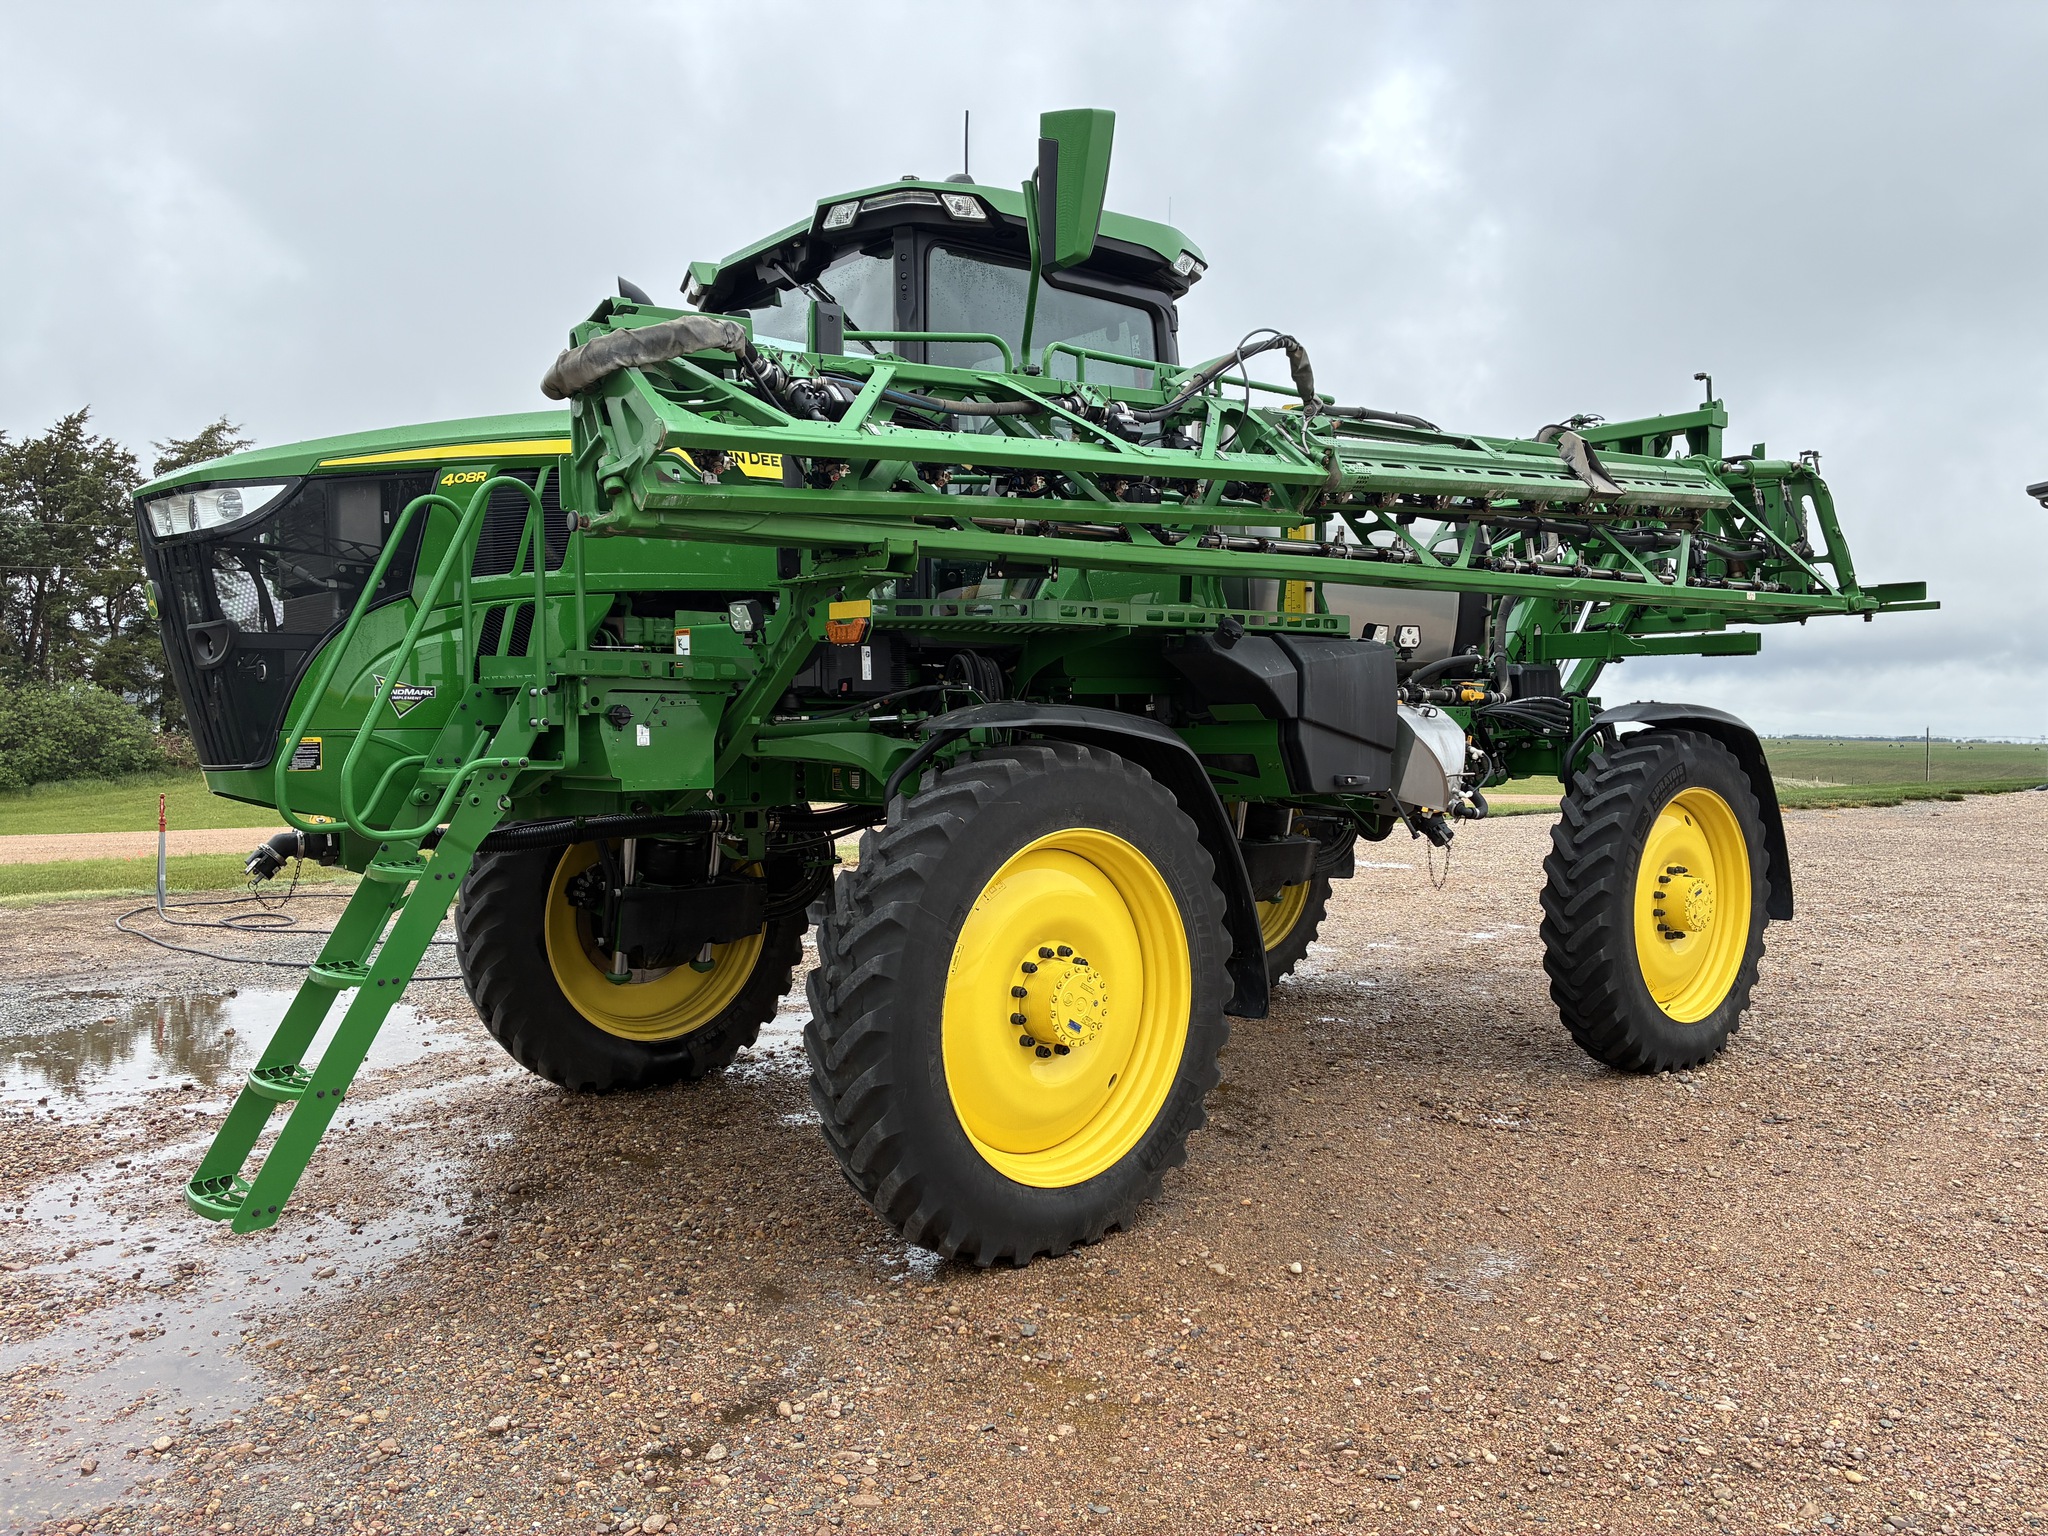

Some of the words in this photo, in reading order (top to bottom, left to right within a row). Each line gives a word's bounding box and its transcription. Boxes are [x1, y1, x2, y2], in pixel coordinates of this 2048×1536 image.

[748, 452, 781, 468] DEE
[440, 471, 487, 486] 408R
[378, 688, 434, 696] NDMARK
